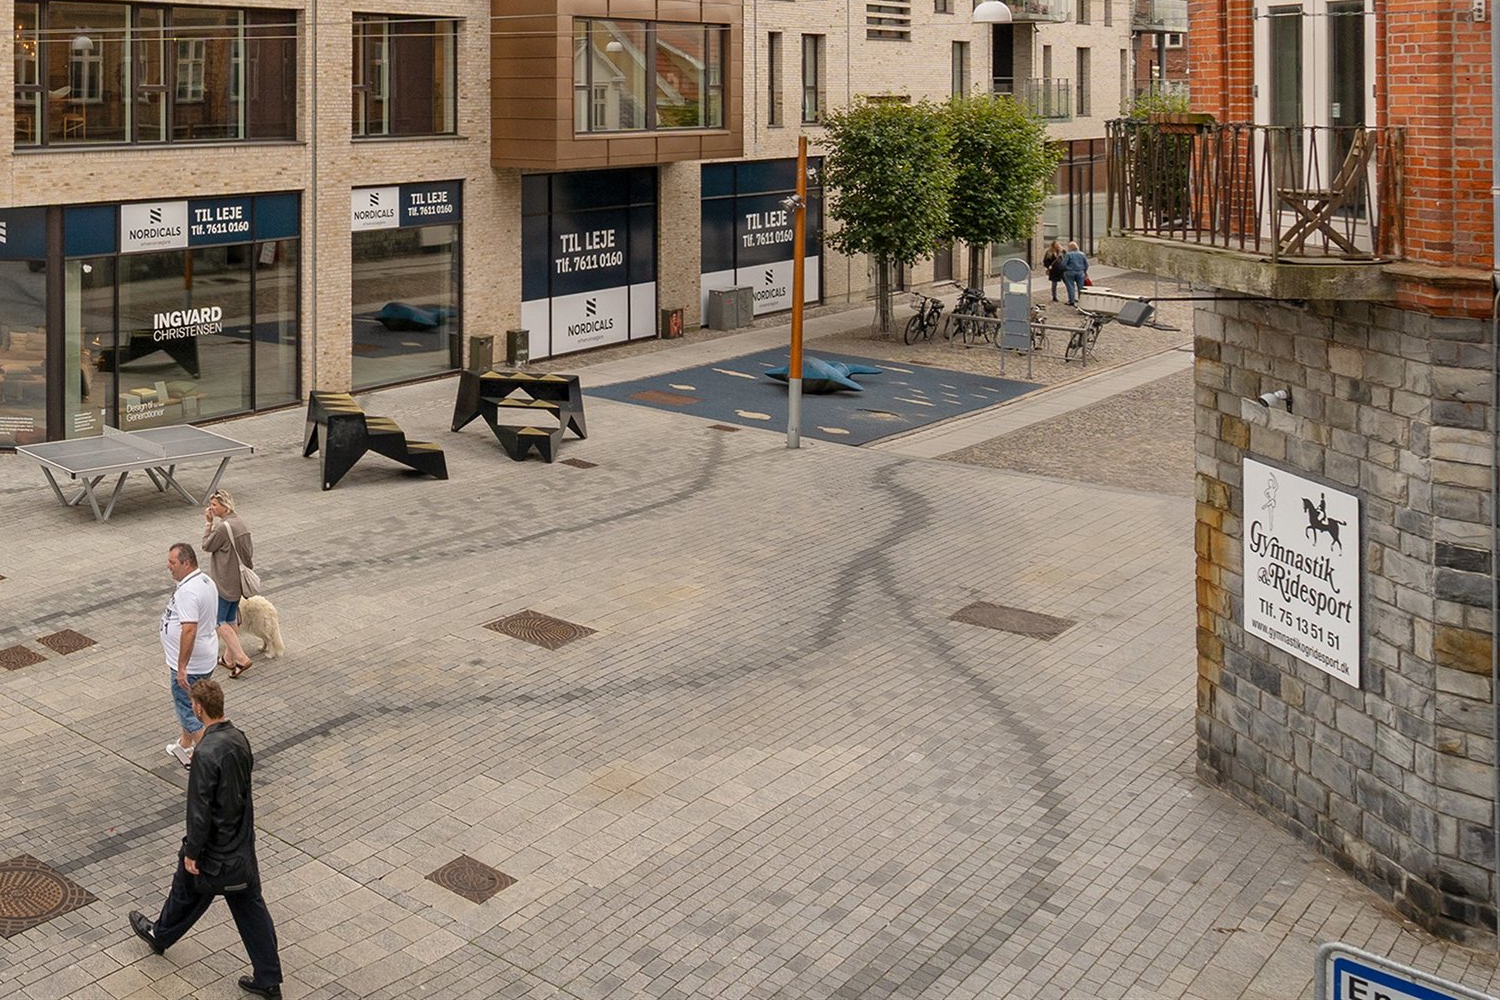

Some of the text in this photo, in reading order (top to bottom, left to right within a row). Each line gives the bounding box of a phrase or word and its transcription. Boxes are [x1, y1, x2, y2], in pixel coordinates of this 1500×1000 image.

[410, 191, 448, 205] TIL LEJE
[195, 206, 242, 222] TIL LEJE
[354, 209, 394, 221] NORDICALS
[420, 206, 436, 216] 7611
[436, 204, 453, 214] 0160
[206, 223, 227, 235] 7611
[228, 221, 249, 233] 0160
[745, 210, 787, 230] TIL LEJE
[129, 226, 181, 240] NORDICALS
[560, 229, 616, 253] TIL LEJE
[755, 231, 775, 246] 7611
[775, 229, 794, 244] 0160
[555, 250, 623, 274] Tlf. 7611 0160
[153, 306, 222, 330] INGVARD
[567, 318, 614, 337] NORDICALS
[153, 322, 223, 342] CHRISTENSEN
[1250, 520, 1340, 594] Gymnastik
[1268, 562, 1353, 624] Ridesport
[1259, 597, 1340, 651] Tlf. 75 13 51 51
